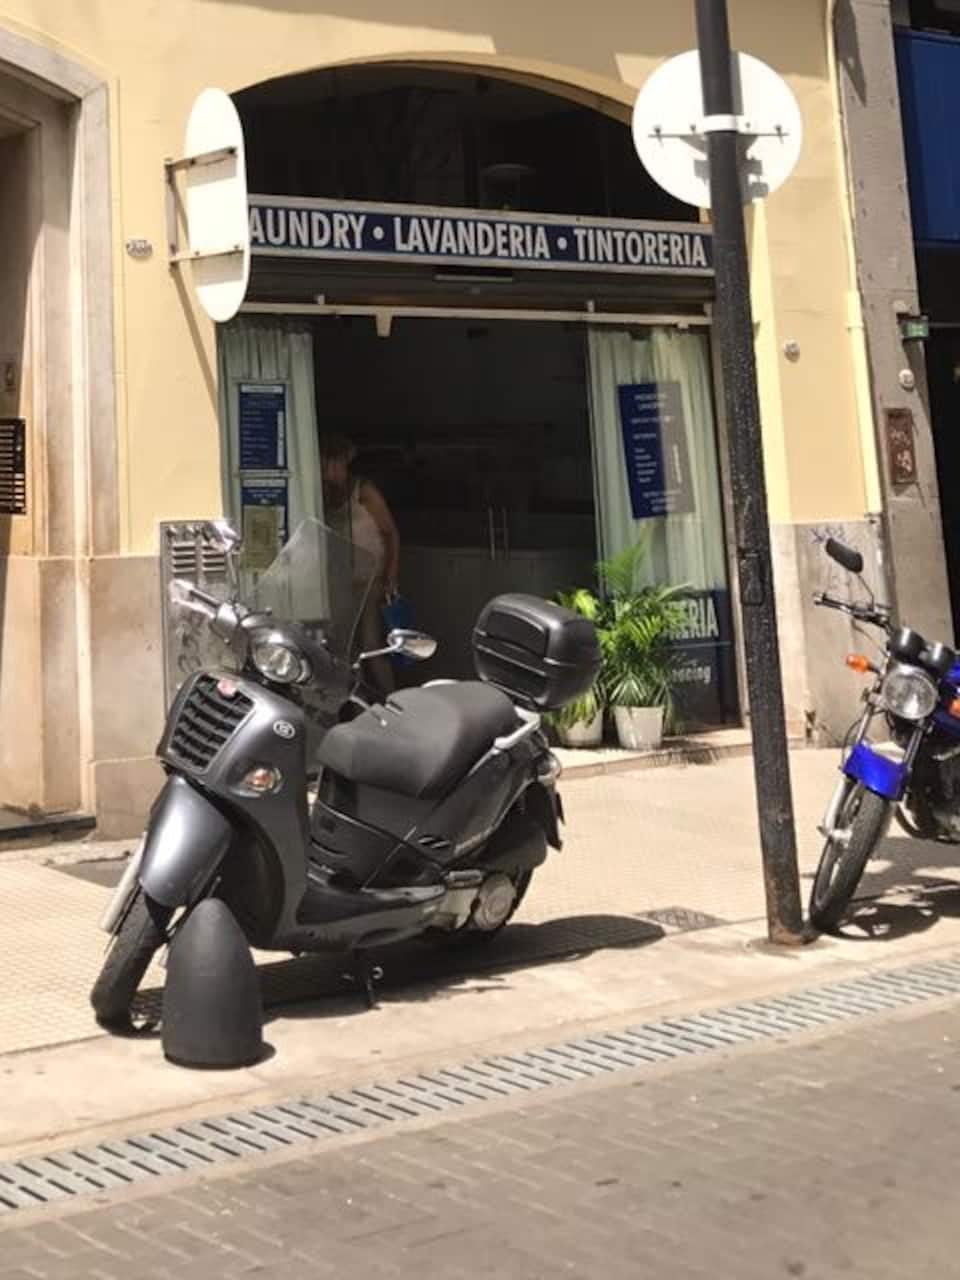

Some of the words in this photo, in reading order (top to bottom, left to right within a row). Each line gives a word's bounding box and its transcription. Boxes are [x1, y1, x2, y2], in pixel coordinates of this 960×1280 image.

[249, 207, 367, 250] AUNDRY
[394, 216, 551, 260] LAVANDERIA
[573, 227, 708, 267] TINTORERIA
